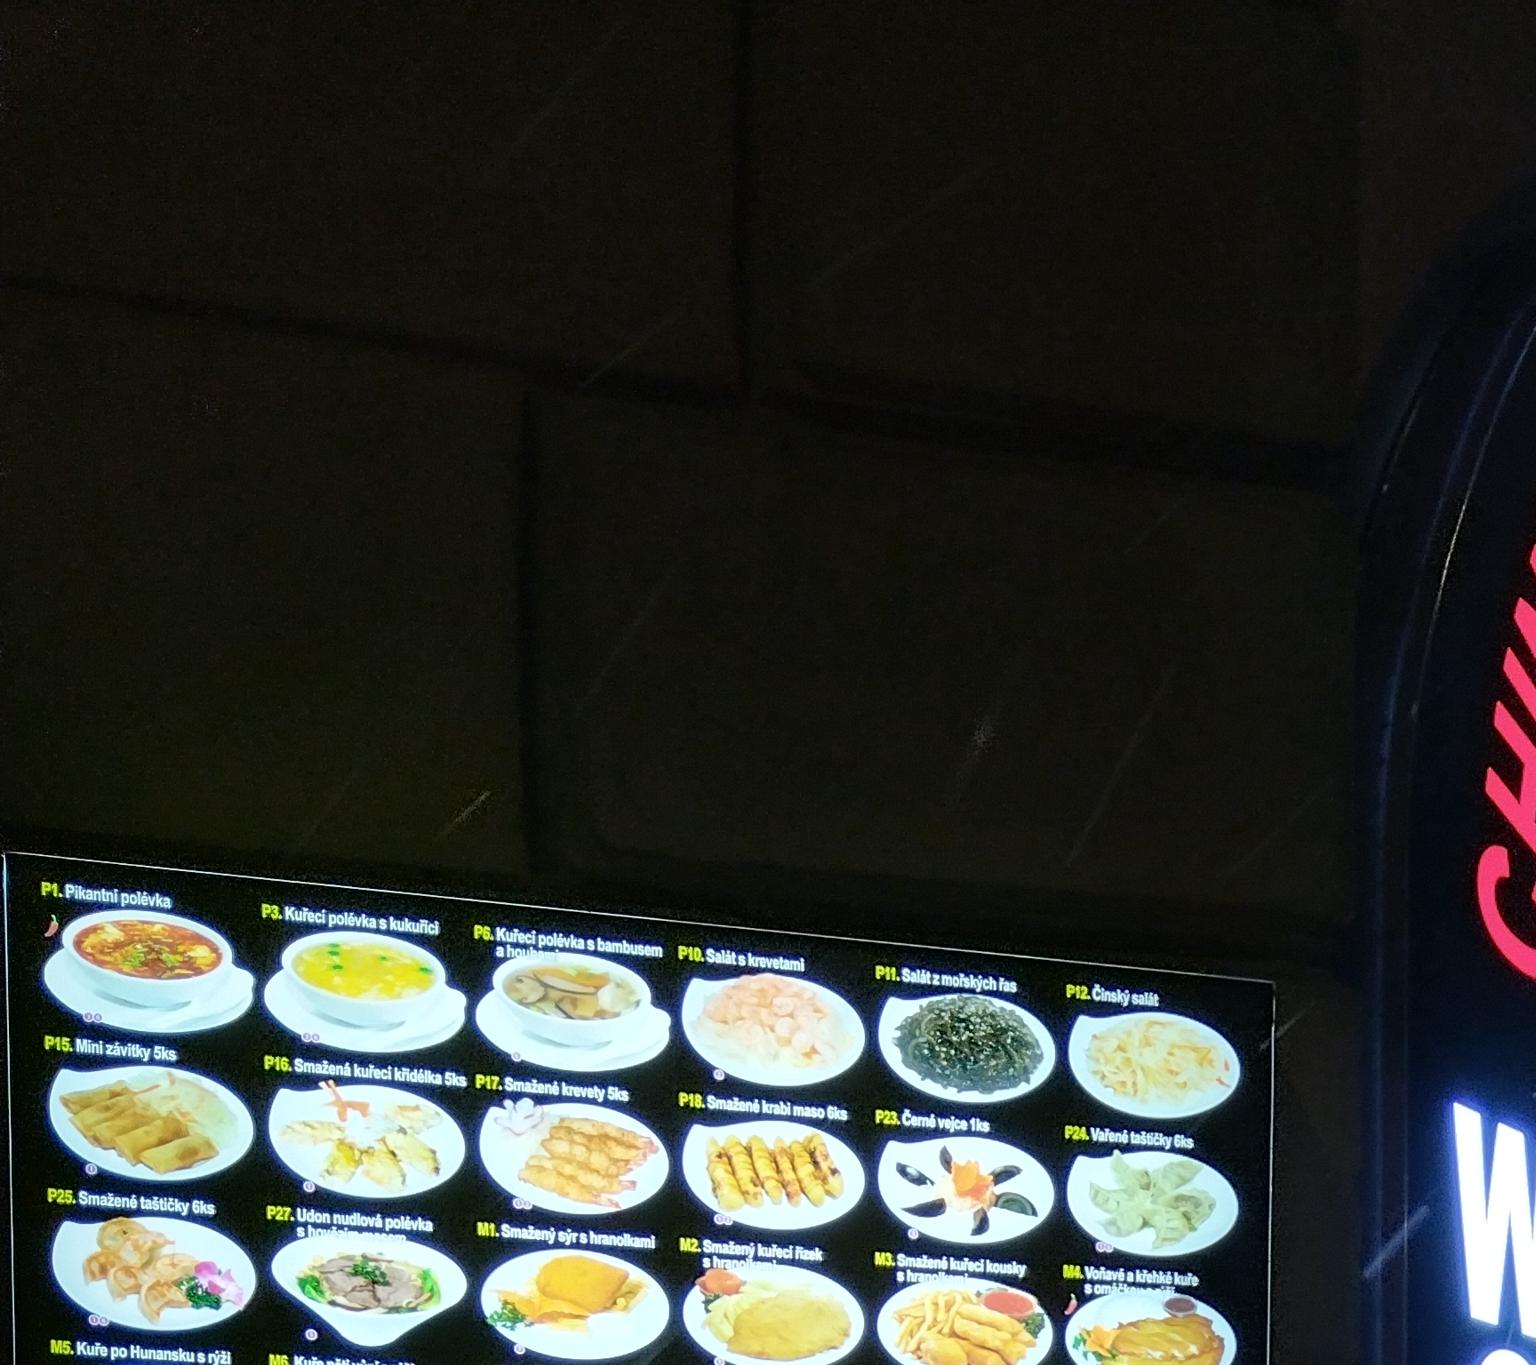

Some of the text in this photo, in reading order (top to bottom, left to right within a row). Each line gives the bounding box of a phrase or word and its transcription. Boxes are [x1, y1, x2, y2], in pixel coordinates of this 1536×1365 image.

[41, 881, 63, 898] P1.
[120, 891, 172, 909] polévka
[262, 903, 282, 920] P3.
[328, 912, 377, 929] polévka
[378, 918, 388, 930] s
[678, 945, 805, 972] P10. Salát s krevetami
[875, 965, 1017, 993] P11. Salát z mořských řas
[44, 1035, 73, 1052] P15.
[76, 1038, 103, 1055] Mini
[153, 1045, 177, 1061] 5ks
[264, 1055, 292, 1072] P16.
[294, 1057, 352, 1077] Smažená
[444, 1071, 467, 1087] 5ks
[475, 1074, 629, 1102] P17. Smažené krevety 5ks
[706, 1095, 761, 1114] Smažené
[792, 1105, 826, 1119] maso
[826, 1105, 848, 1121] 6ks
[875, 1108, 990, 1133] P23. Černé vejce 1ks
[1064, 1125, 1194, 1150] P24. Vařené taštičky 6ks
[47, 1187, 216, 1216] P25. Smažené taštičky 6ks
[267, 1205, 433, 1232] P27. Udon nudlová polévka
[477, 1222, 656, 1249] M1. Smažený sýr s hranolkami
[51, 1339, 74, 1355] M5.
[76, 1341, 108, 1357] Kuře
[110, 1346, 128, 1360] po
[130, 1344, 195, 1362] Hunansku
[197, 1352, 206, 1364] s
